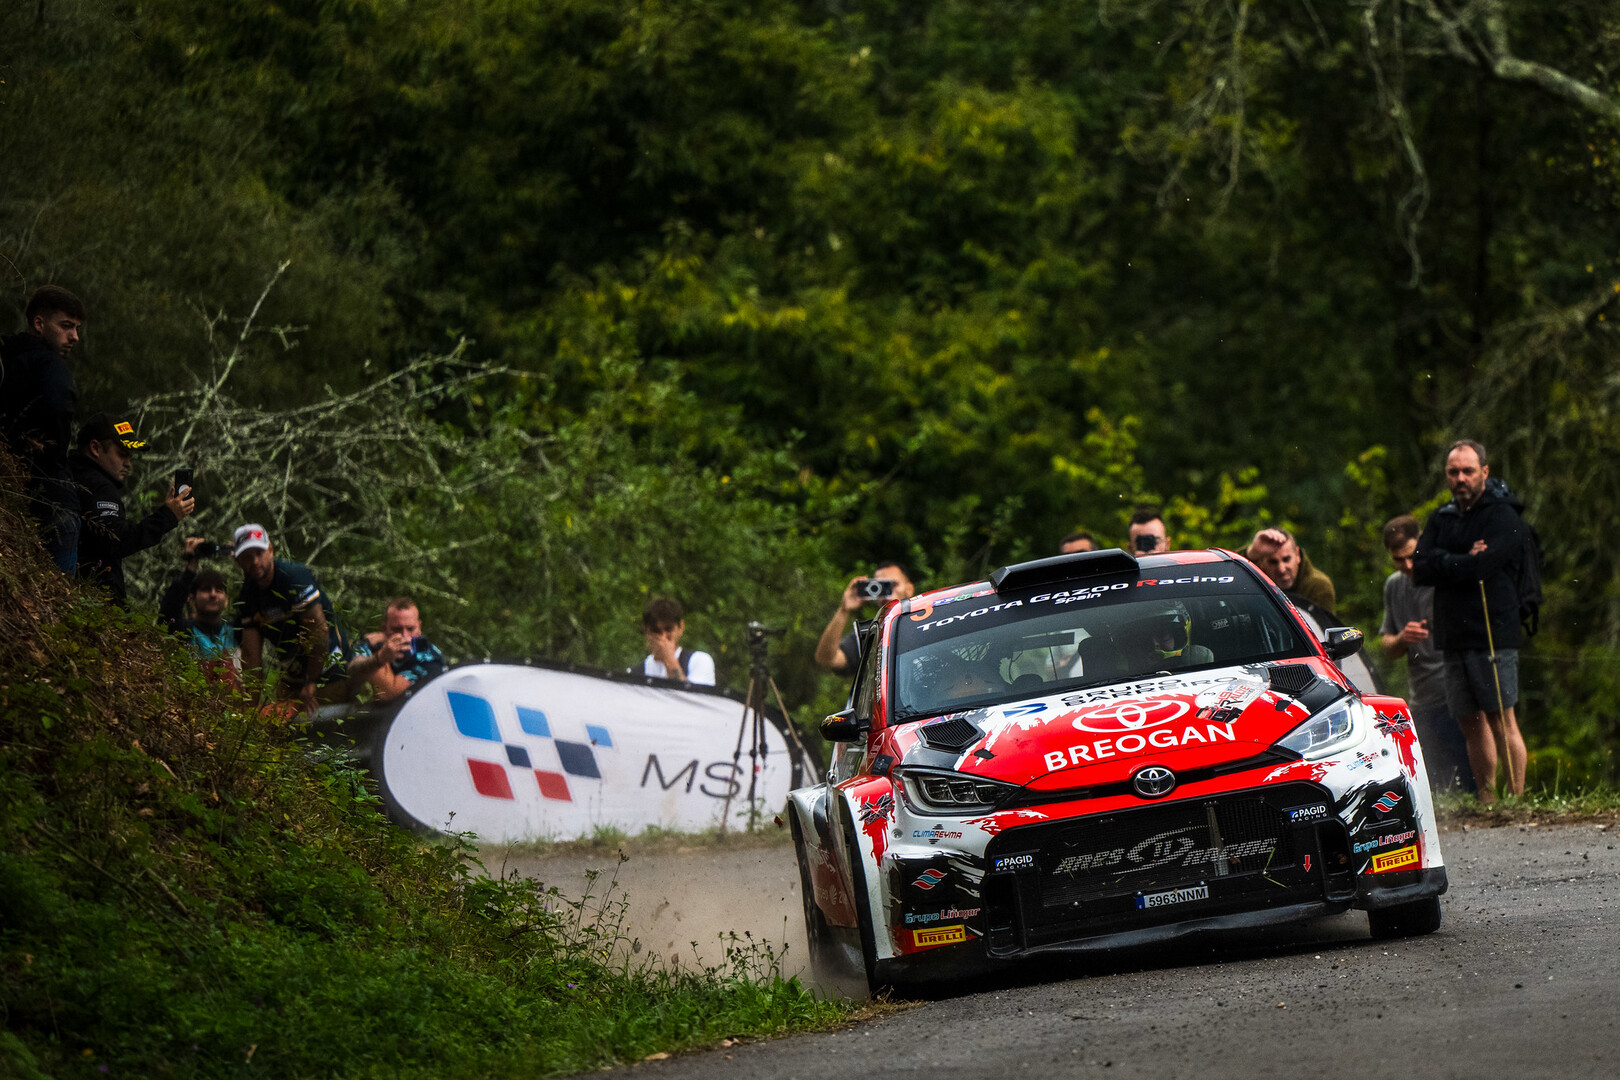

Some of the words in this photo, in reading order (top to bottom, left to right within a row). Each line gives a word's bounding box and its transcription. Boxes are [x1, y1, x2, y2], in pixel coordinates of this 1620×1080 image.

[916, 600, 1024, 632] TOYOTA
[1029, 582, 1130, 604] GAZOO
[1136, 575, 1235, 588] Racing
[1054, 592, 1102, 606] Spain
[1061, 679, 1182, 702] GRUPO
[1064, 676, 1238, 707] BARREIRO
[1044, 723, 1237, 773] BREOGAN
[1299, 805, 1326, 817] PAGID
[912, 830, 963, 839] CLIMAREYMA
[1353, 839, 1378, 853] Grupo
[1003, 855, 1033, 867] PAGID
[1375, 849, 1415, 869] PIRELLI
[995, 863, 1034, 871] RACING
[1148, 888, 1207, 907] 5963NNM
[904, 911, 939, 924] Grupo
[917, 928, 963, 944] PIRELLI
